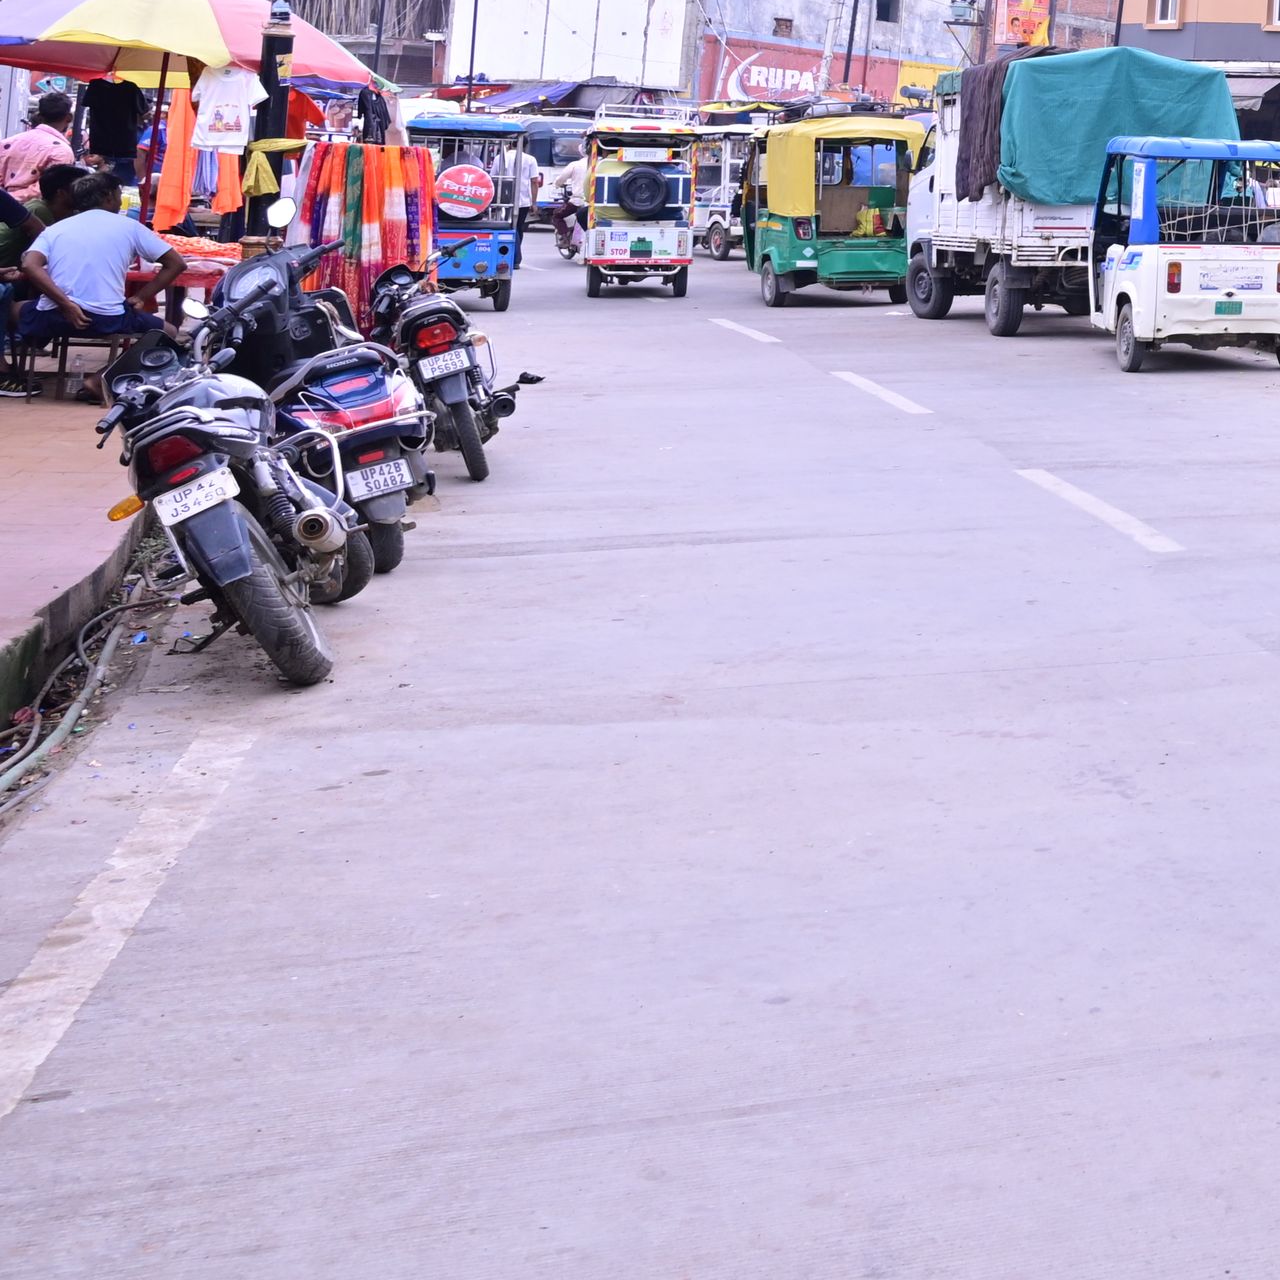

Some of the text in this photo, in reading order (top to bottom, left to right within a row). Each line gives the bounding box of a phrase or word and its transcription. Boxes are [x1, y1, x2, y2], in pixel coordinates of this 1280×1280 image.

[750, 65, 815, 92] RUPA
[610, 248, 628, 256] STOP
[326, 358, 358, 369] HONDA
[431, 360, 464, 375] P5693
[360, 462, 402, 481] UP42B
[365, 474, 406, 493] S0482
